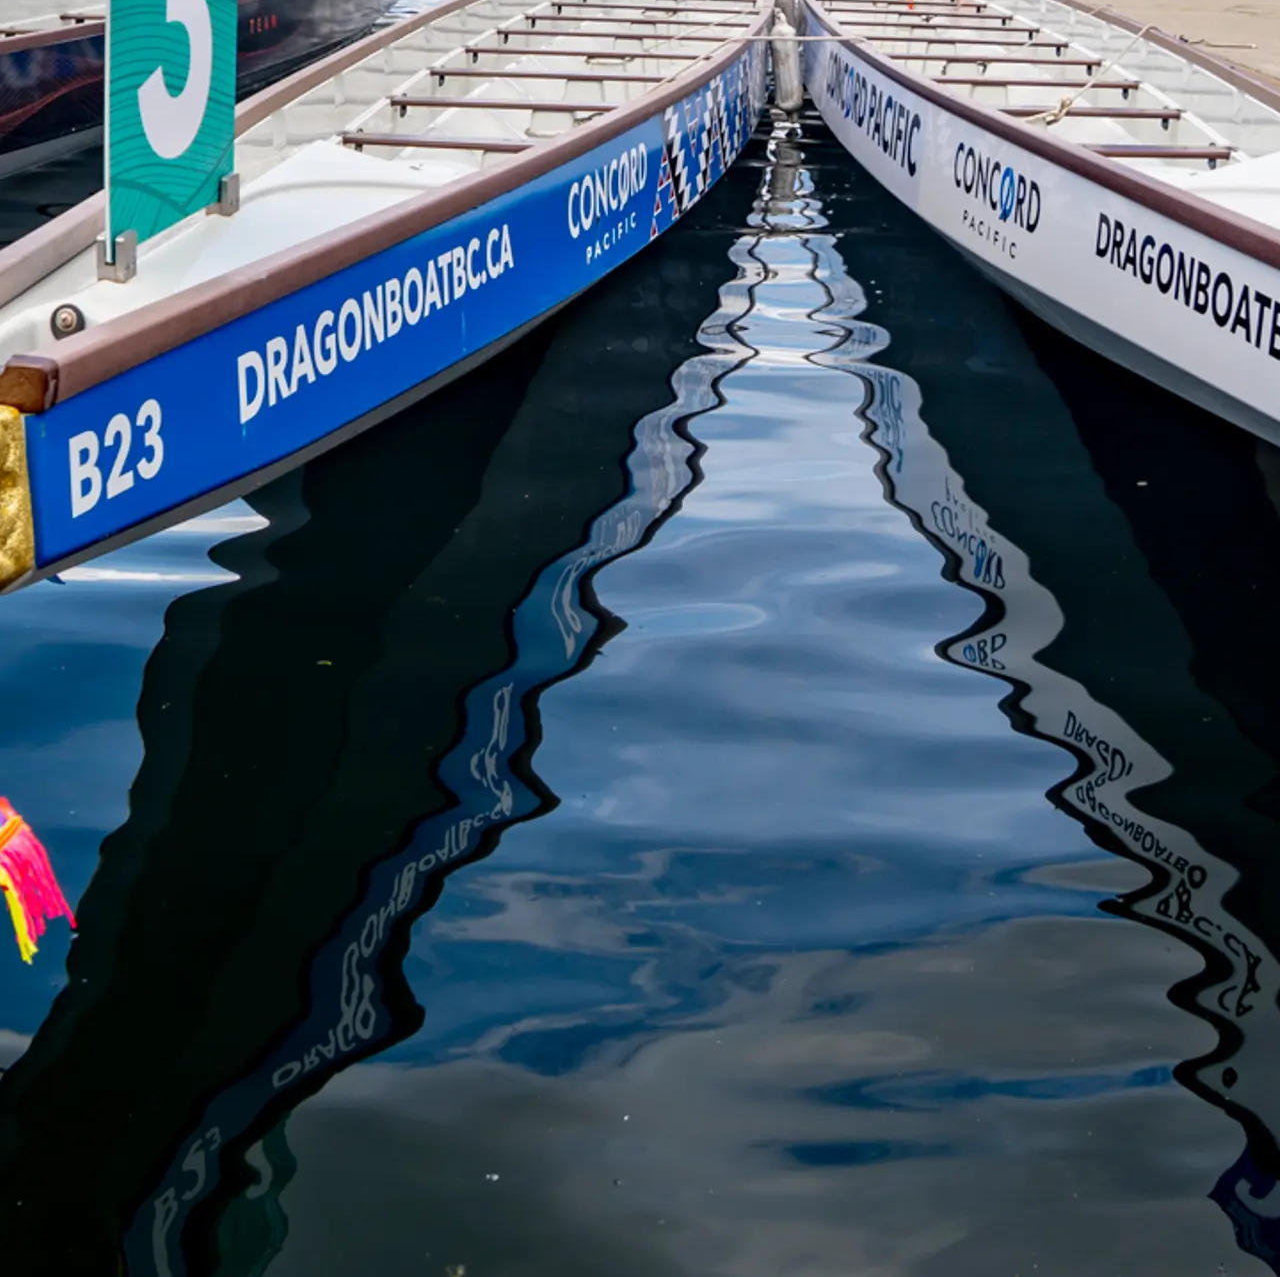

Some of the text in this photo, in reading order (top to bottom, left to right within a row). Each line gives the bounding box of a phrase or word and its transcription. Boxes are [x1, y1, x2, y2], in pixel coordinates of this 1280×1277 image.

[866, 83, 921, 178] PACIFIC
[585, 211, 637, 265] PACIFIC
[962, 209, 1018, 260] PACIFIC
[237, 224, 515, 425] DRAGONBOATBC.CA
[68, 398, 165, 519] B23
